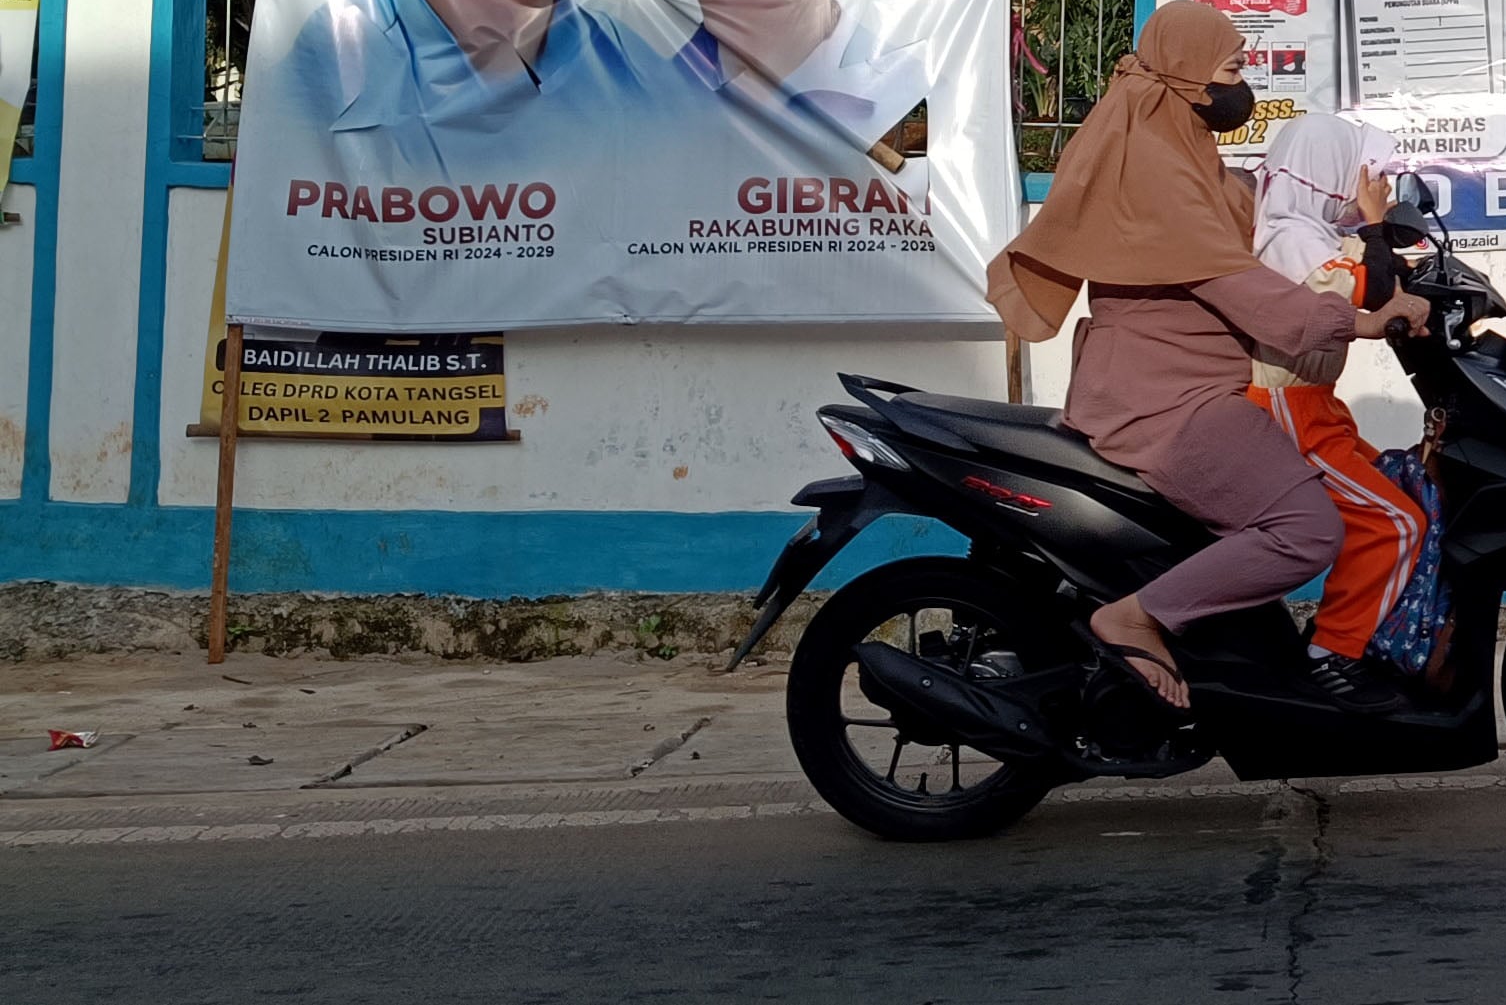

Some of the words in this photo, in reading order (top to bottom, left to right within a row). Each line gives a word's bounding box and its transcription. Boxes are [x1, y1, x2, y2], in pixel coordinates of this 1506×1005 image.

[1250, 119, 1268, 144] 2
[1394, 138, 1430, 154] RNA
[1435, 137, 1481, 153] BIRU
[286, 179, 556, 223] PRABOWO
[423, 223, 555, 245] SUBIANTO
[689, 218, 860, 238] RAKABUMING
[869, 219, 934, 237] RAKA
[307, 245, 362, 259] CALON
[364, 248, 437, 261] PRESIDEN
[443, 249, 459, 260] RI
[464, 248, 502, 260] 2024
[516, 246, 555, 258] 2029
[628, 243, 684, 255] CALON
[690, 242, 742, 254] WAKIL
[747, 240, 825, 253] PRESIDEN
[828, 240, 842, 252] RI
[847, 240, 885, 252] 2024
[900, 240, 936, 252] 2029
[366, 354, 440, 371] THALIB
[446, 353, 487, 370] S.T.
[212, 381, 277, 398] CLEG
[282, 384, 339, 400] DPRD
[344, 386, 399, 401] KOTA
[404, 385, 502, 401] TANGSEL
[249, 406, 313, 422] DAPIL
[319, 409, 330, 422] 2
[342, 410, 470, 424] PAMULANG
